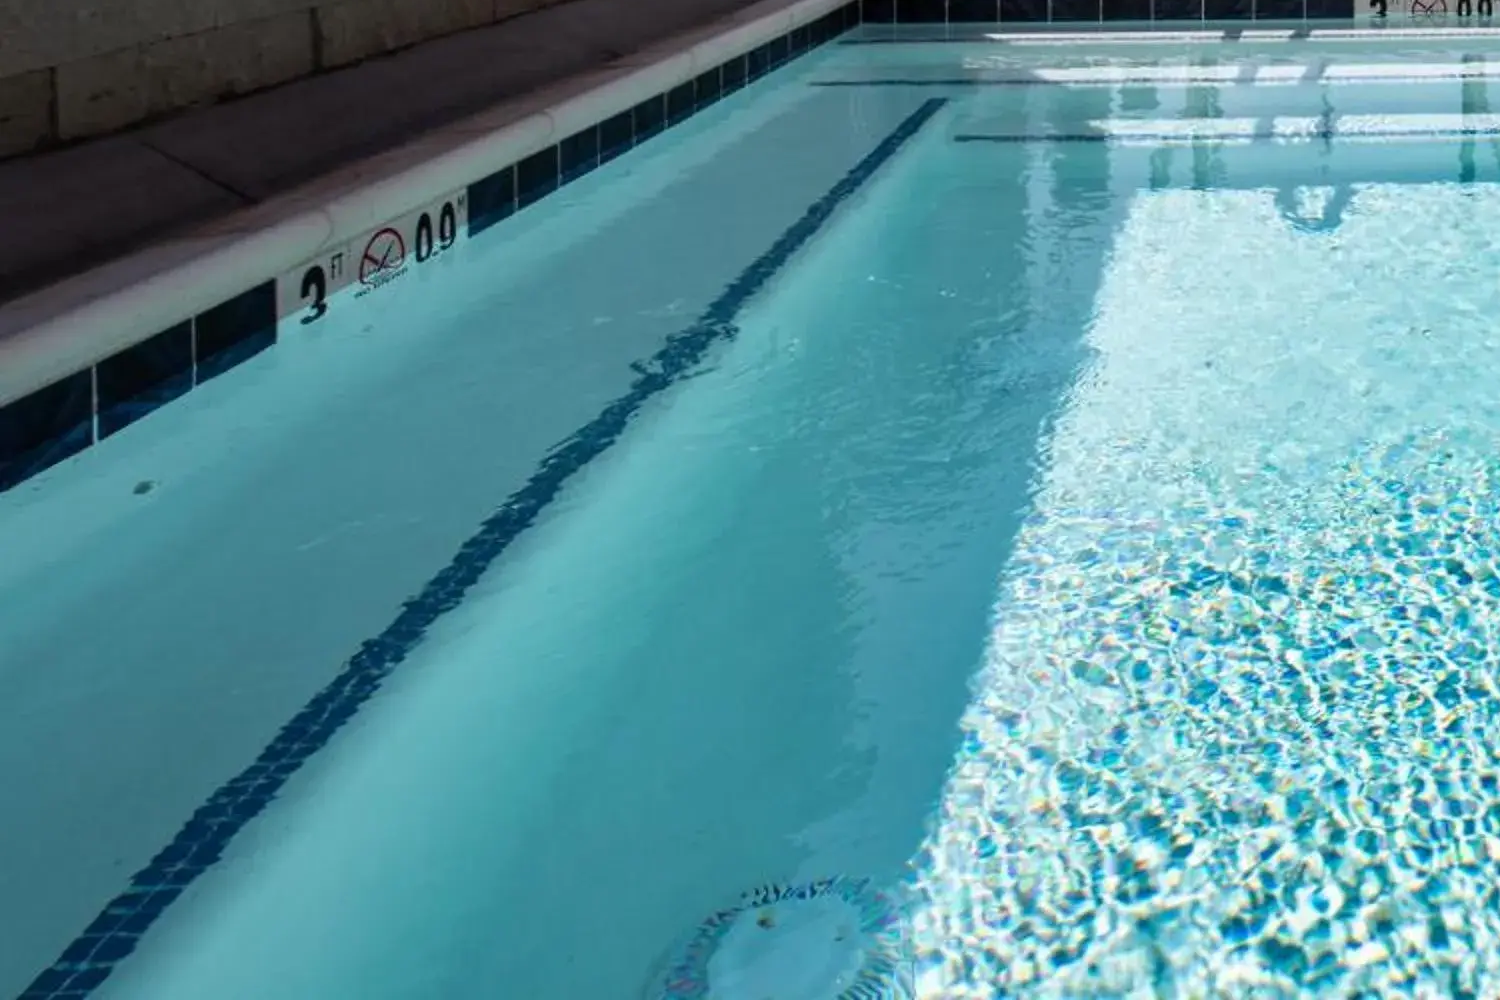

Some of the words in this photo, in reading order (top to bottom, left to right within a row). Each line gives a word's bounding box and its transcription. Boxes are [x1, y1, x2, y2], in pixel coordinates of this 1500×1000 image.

[415, 200, 457, 263] 0.9
[300, 264, 329, 325] 3
[330, 252, 343, 280] FT
